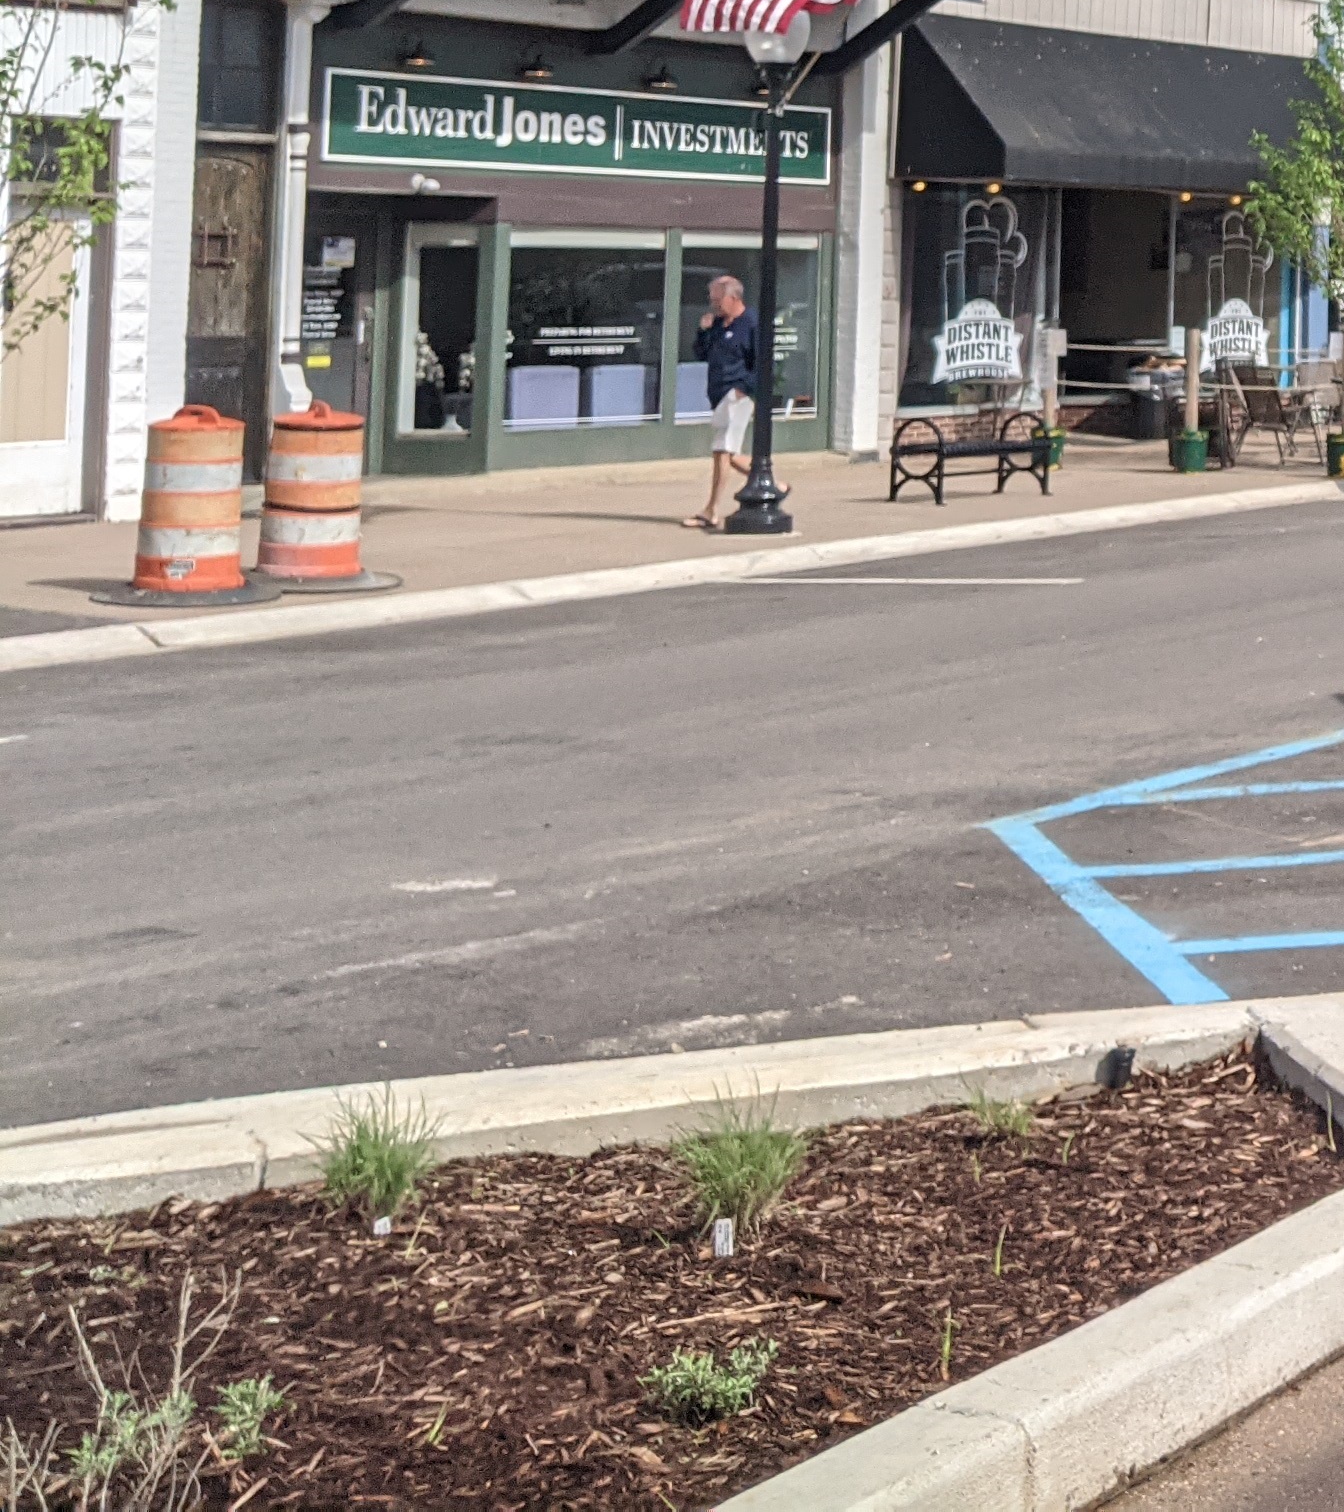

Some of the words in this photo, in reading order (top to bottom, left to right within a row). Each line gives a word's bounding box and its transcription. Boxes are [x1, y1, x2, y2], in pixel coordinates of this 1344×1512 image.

[630, 119, 810, 159] INVESTMETS
[946, 322, 1013, 346] DISTANT
[1210, 319, 1262, 339] DISTANT
[945, 342, 1013, 366] WHISTLE
